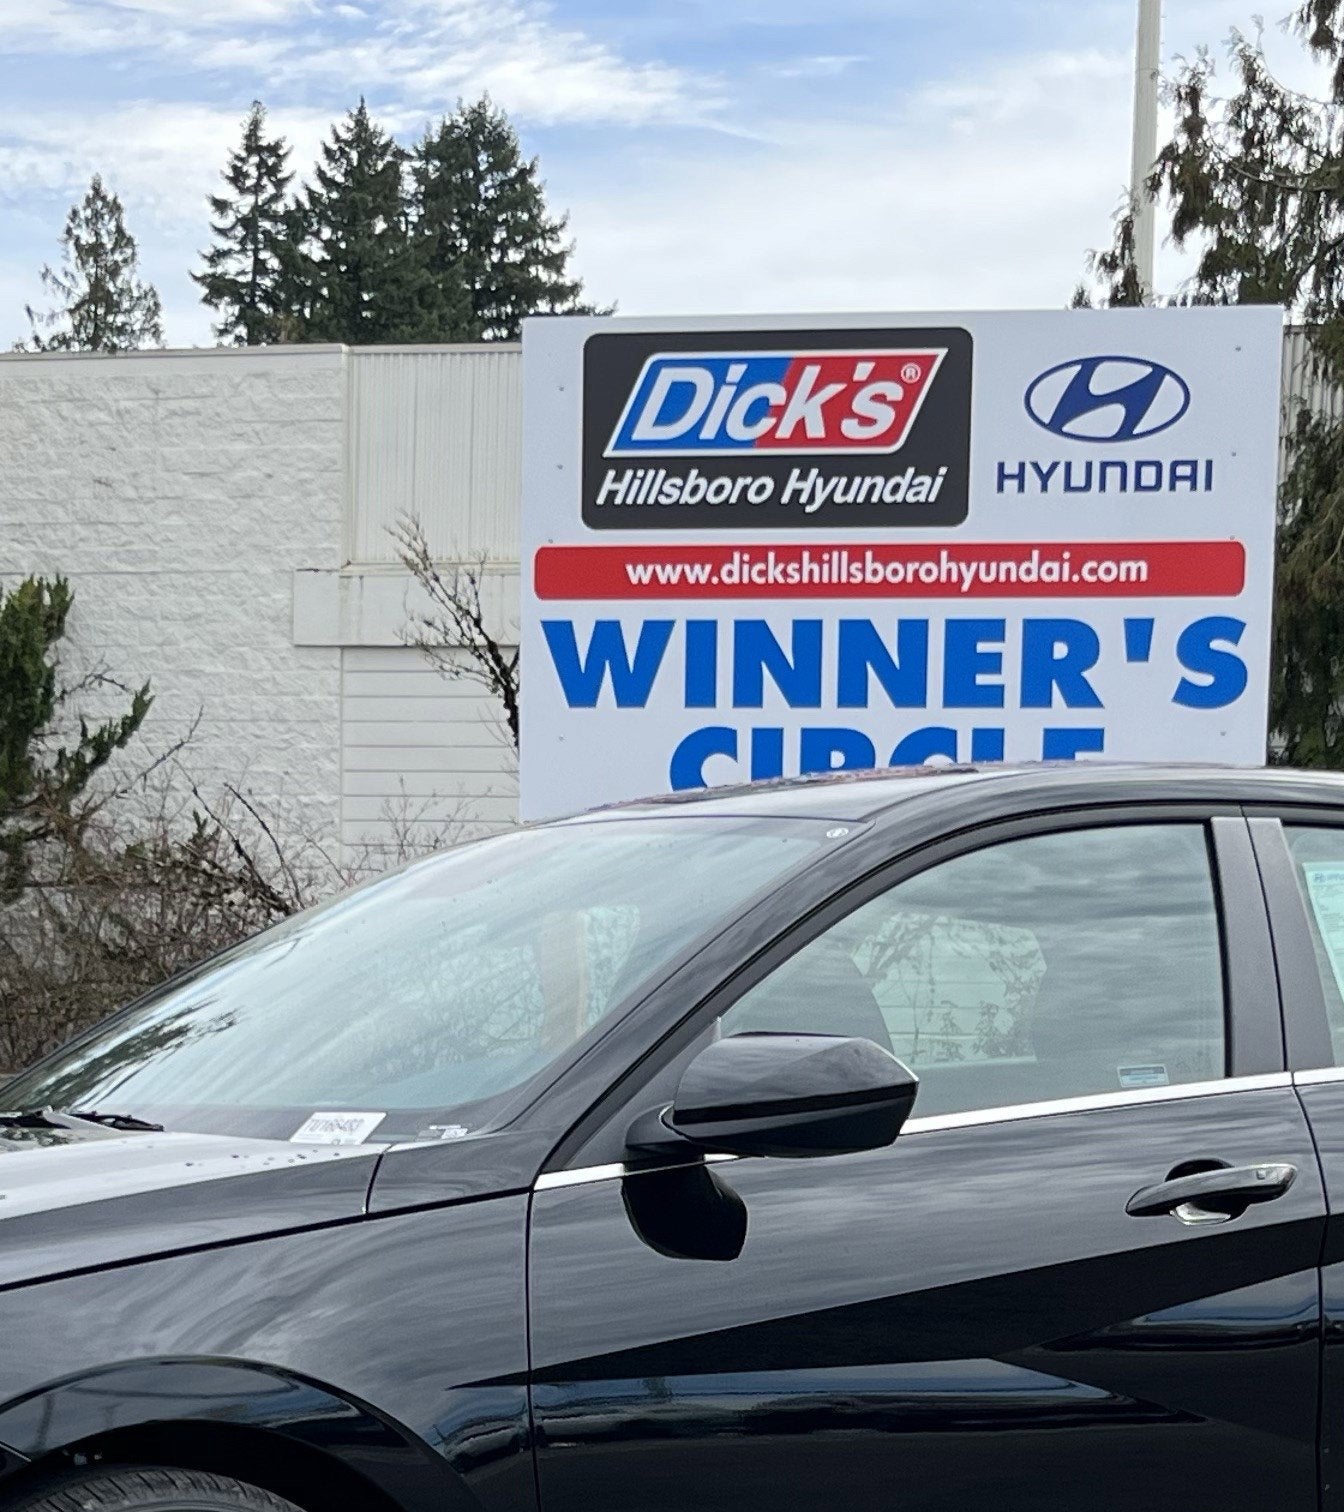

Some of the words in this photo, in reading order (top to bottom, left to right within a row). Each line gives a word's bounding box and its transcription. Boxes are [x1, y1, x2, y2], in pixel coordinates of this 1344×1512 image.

[596, 467, 774, 506] Hillsboro
[780, 465, 949, 512] Hyundai
[996, 458, 1214, 494] HYUNDAI
[626, 548, 1149, 594] www.dickshillsborohyundai.com
[541, 614, 1249, 709] WINNER'S
